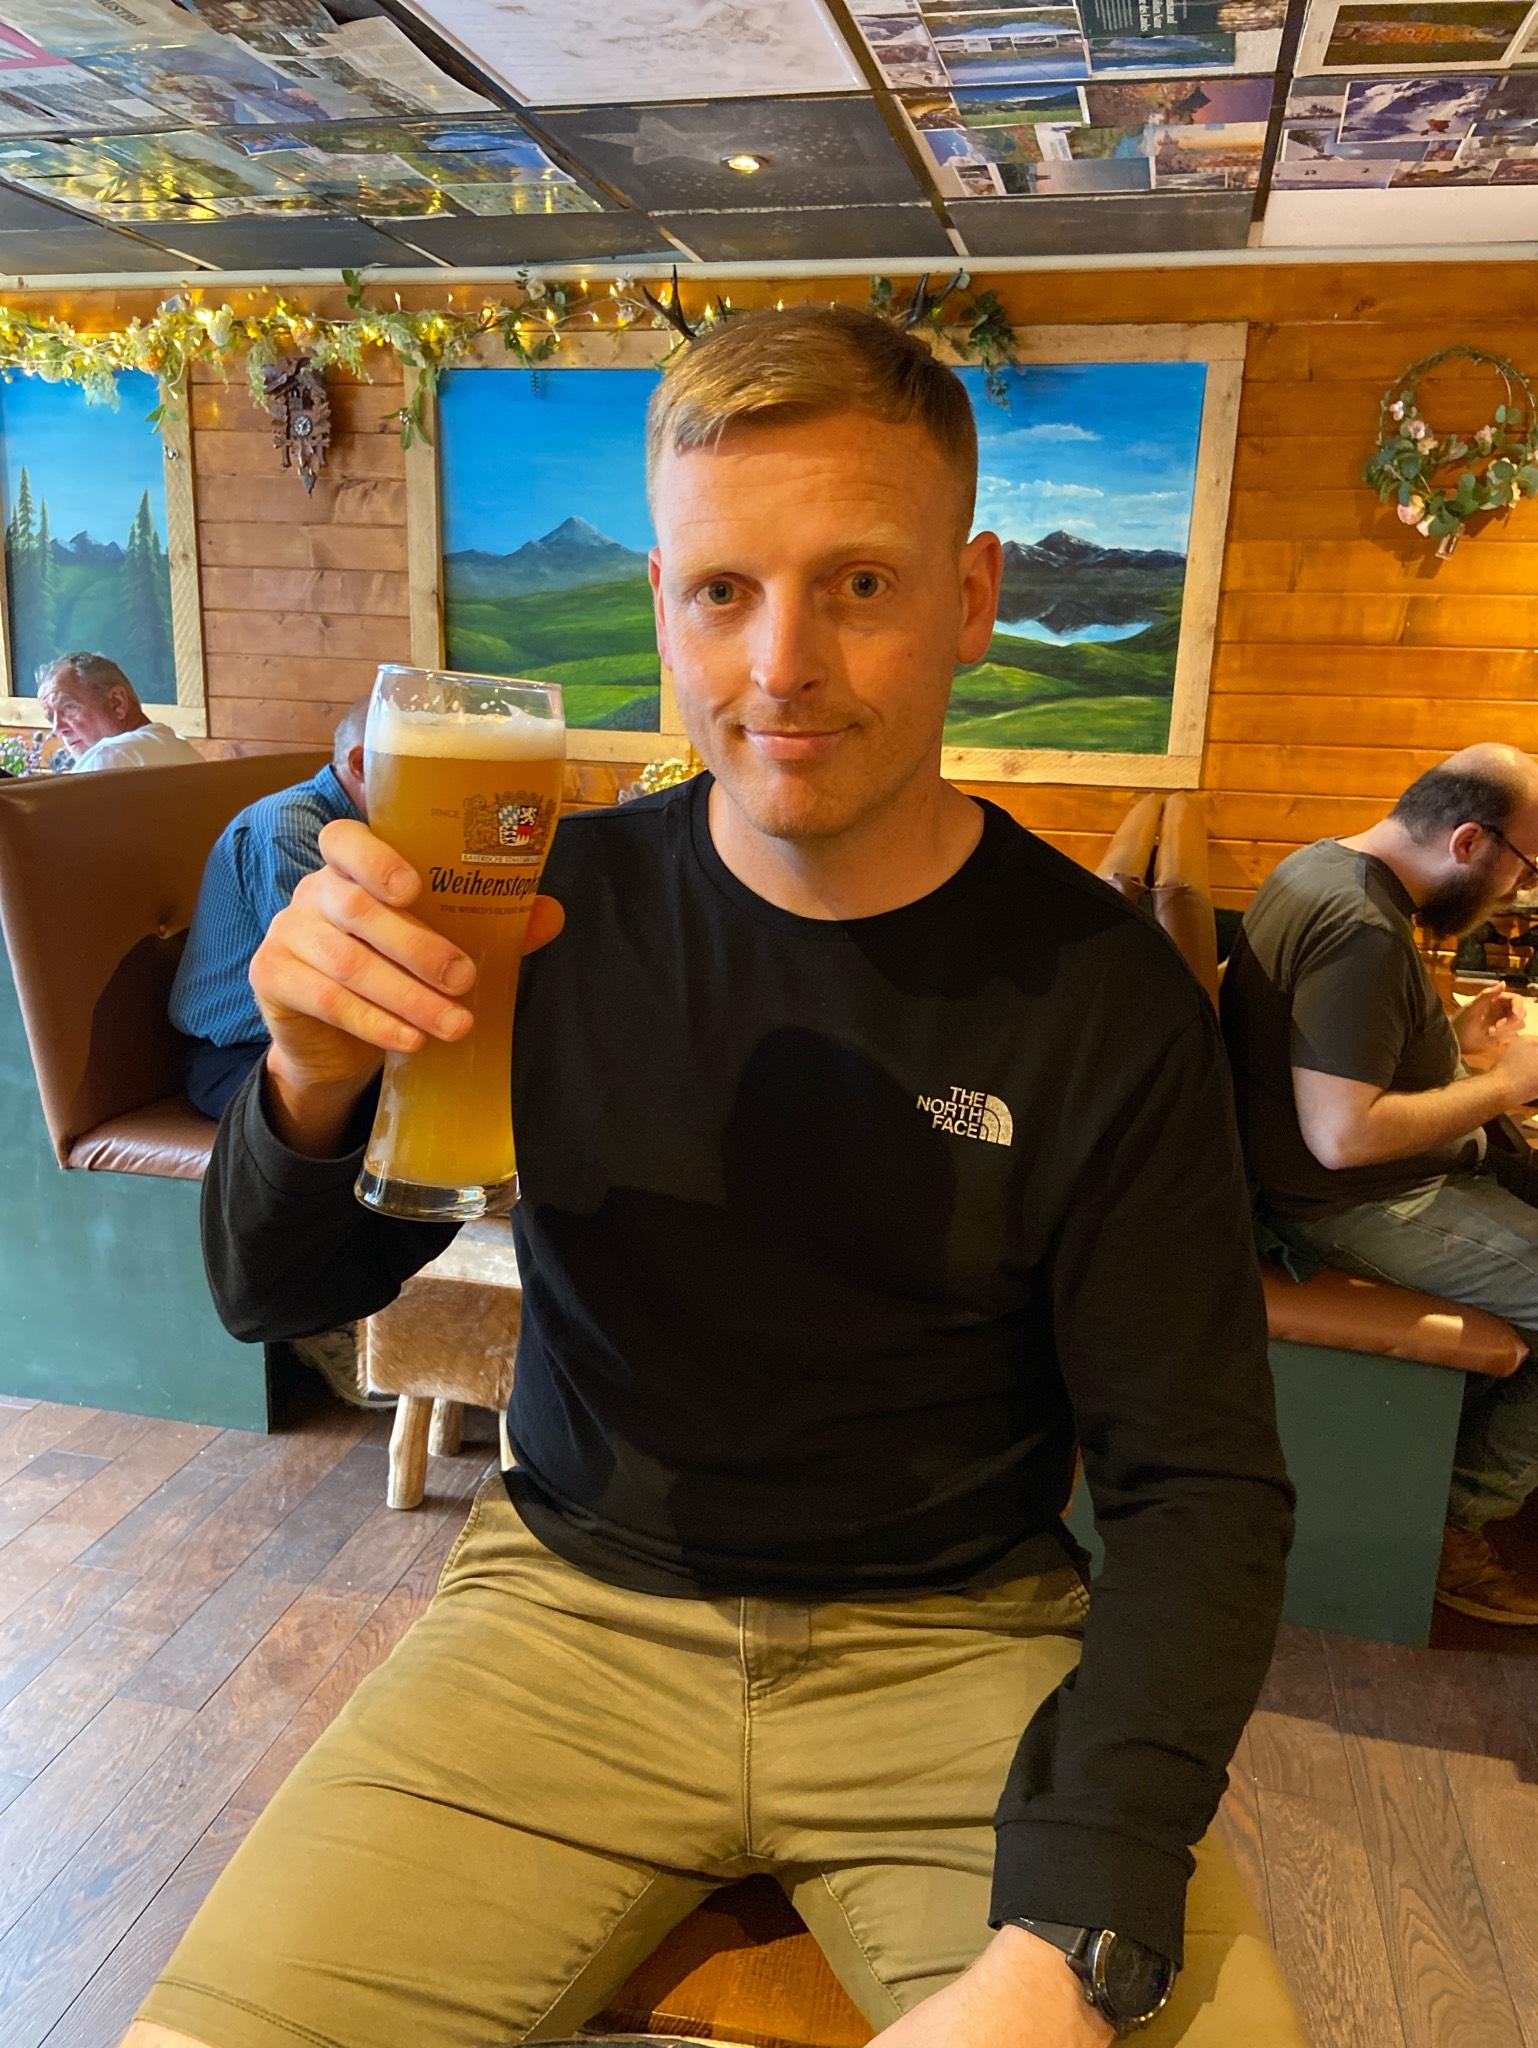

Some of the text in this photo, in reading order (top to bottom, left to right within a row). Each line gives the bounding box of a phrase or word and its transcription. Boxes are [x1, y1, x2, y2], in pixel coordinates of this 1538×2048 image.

[916, 1094, 983, 1124] NORTH
[950, 1086, 985, 1108] THE
[931, 1114, 980, 1139] FACE
